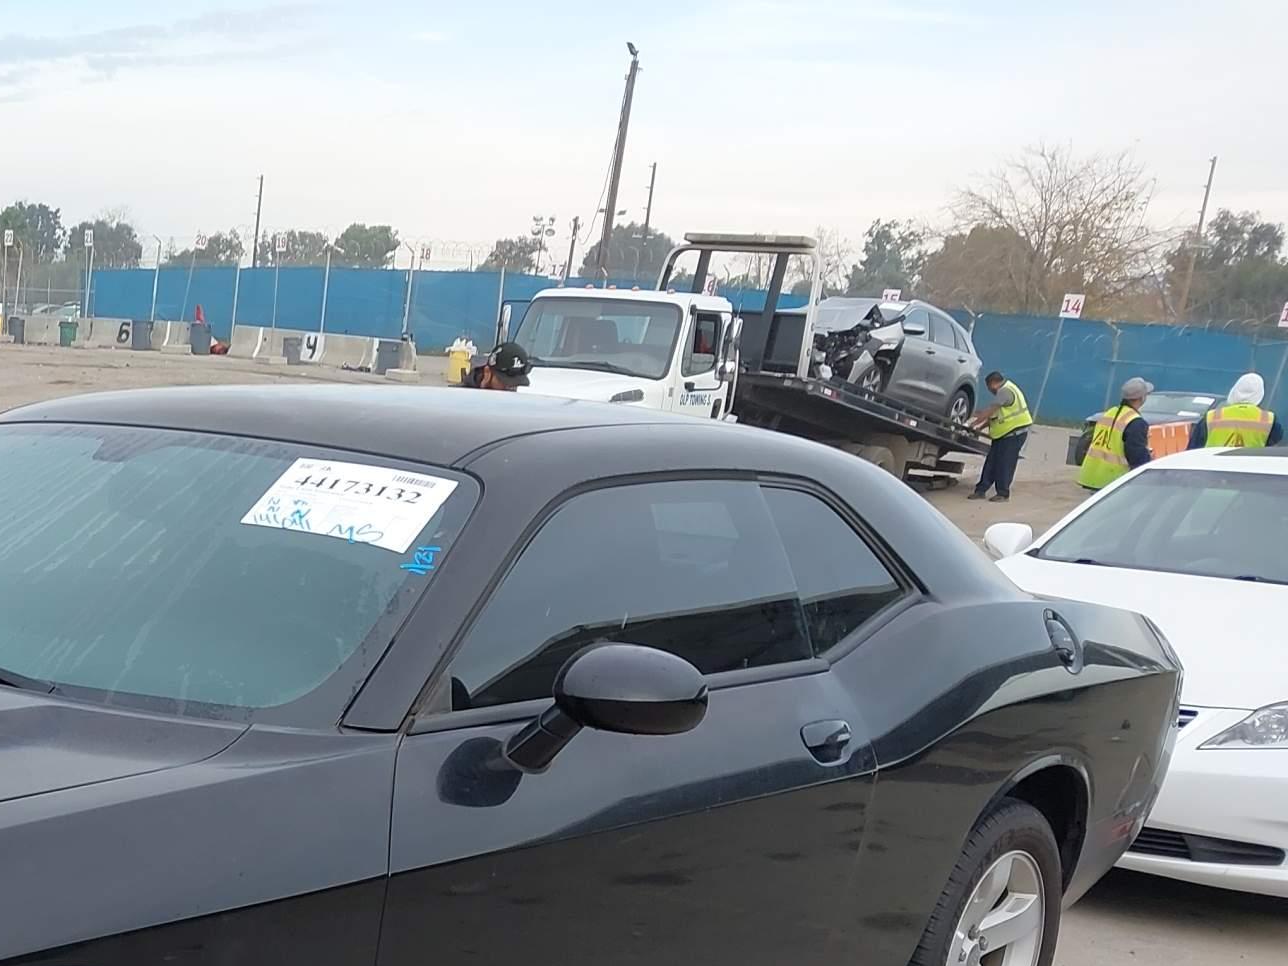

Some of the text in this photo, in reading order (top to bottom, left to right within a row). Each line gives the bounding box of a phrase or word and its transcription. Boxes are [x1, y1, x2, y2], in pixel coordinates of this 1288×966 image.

[1062, 299, 1081, 313] 14
[116, 321, 131, 343] 6
[306, 335, 318, 359] 4
[294, 475, 422, 504] 44173132
